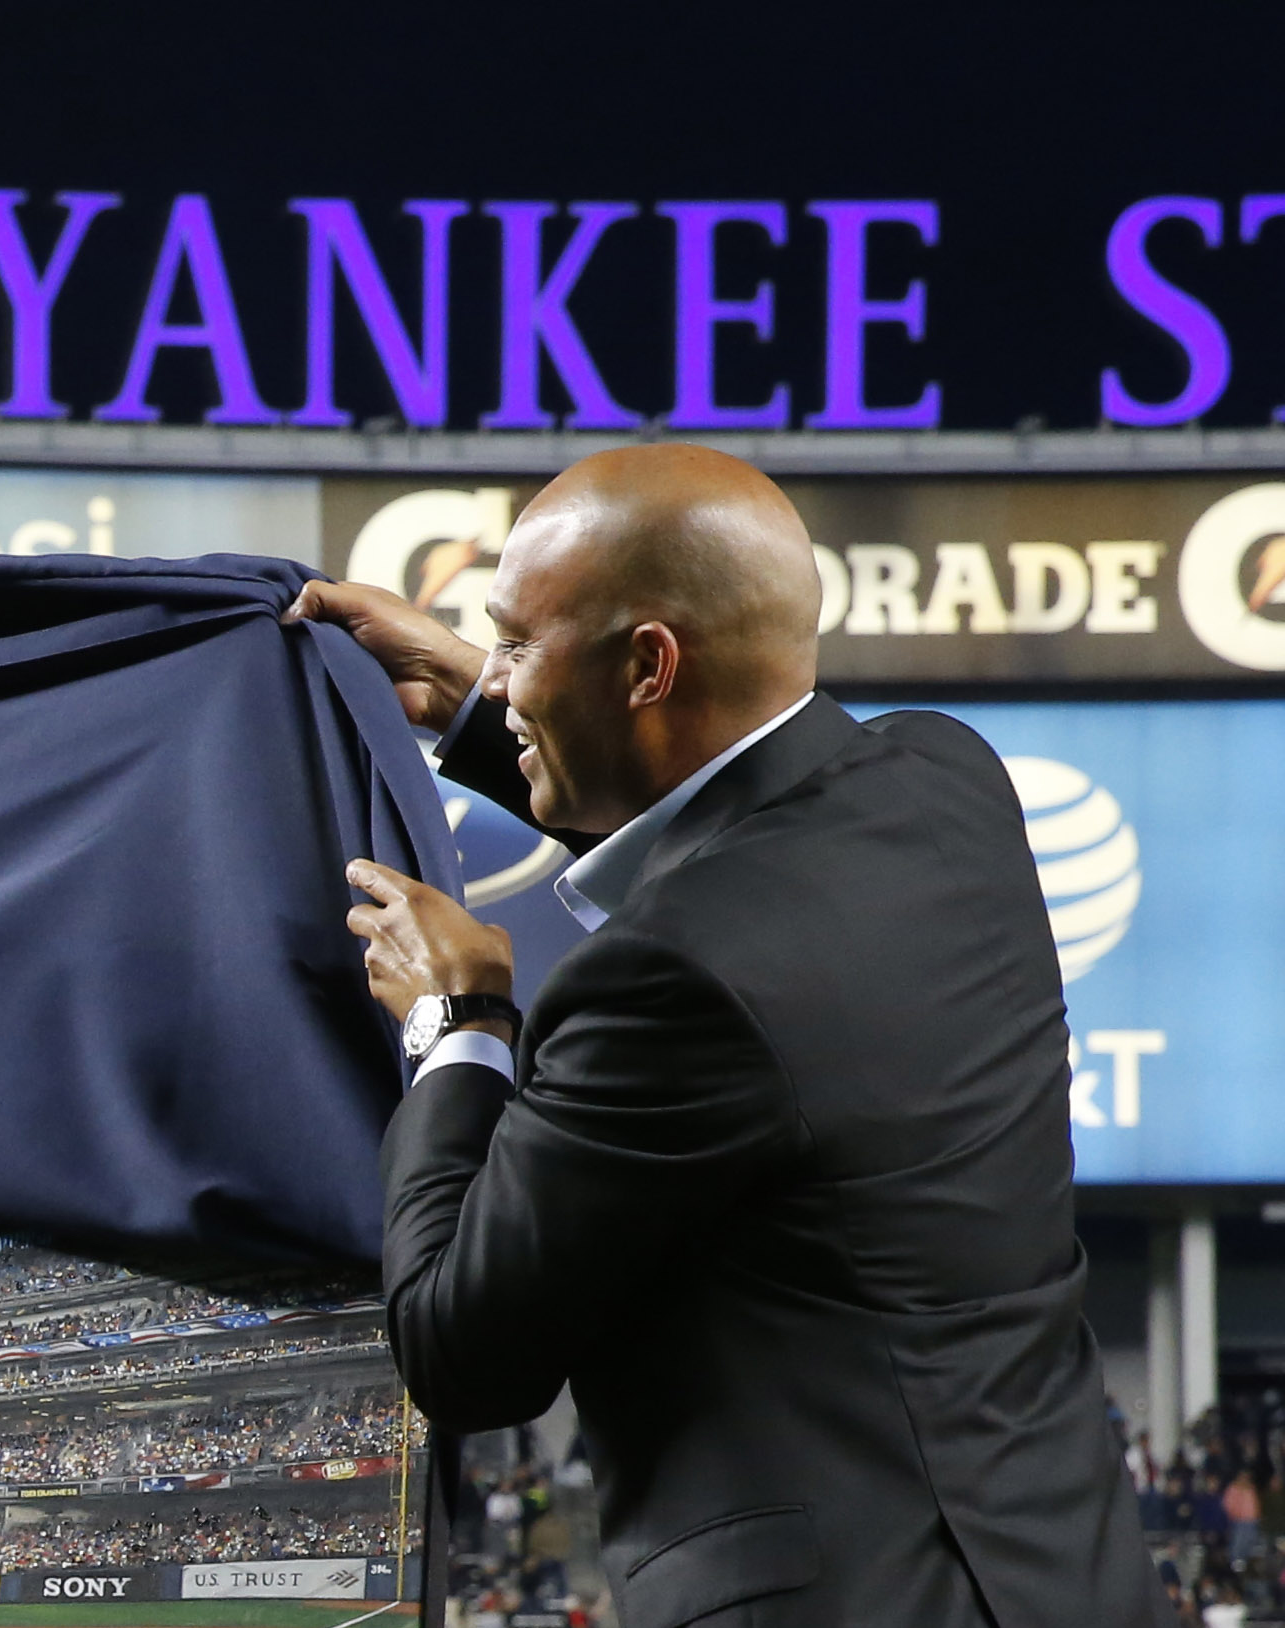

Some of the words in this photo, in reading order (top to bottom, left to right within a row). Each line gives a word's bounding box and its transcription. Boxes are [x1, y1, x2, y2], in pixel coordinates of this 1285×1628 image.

[43, 1576, 132, 1598] SONY
[194, 1573, 220, 1587] U.S.
[231, 1571, 303, 1587] TRUST
